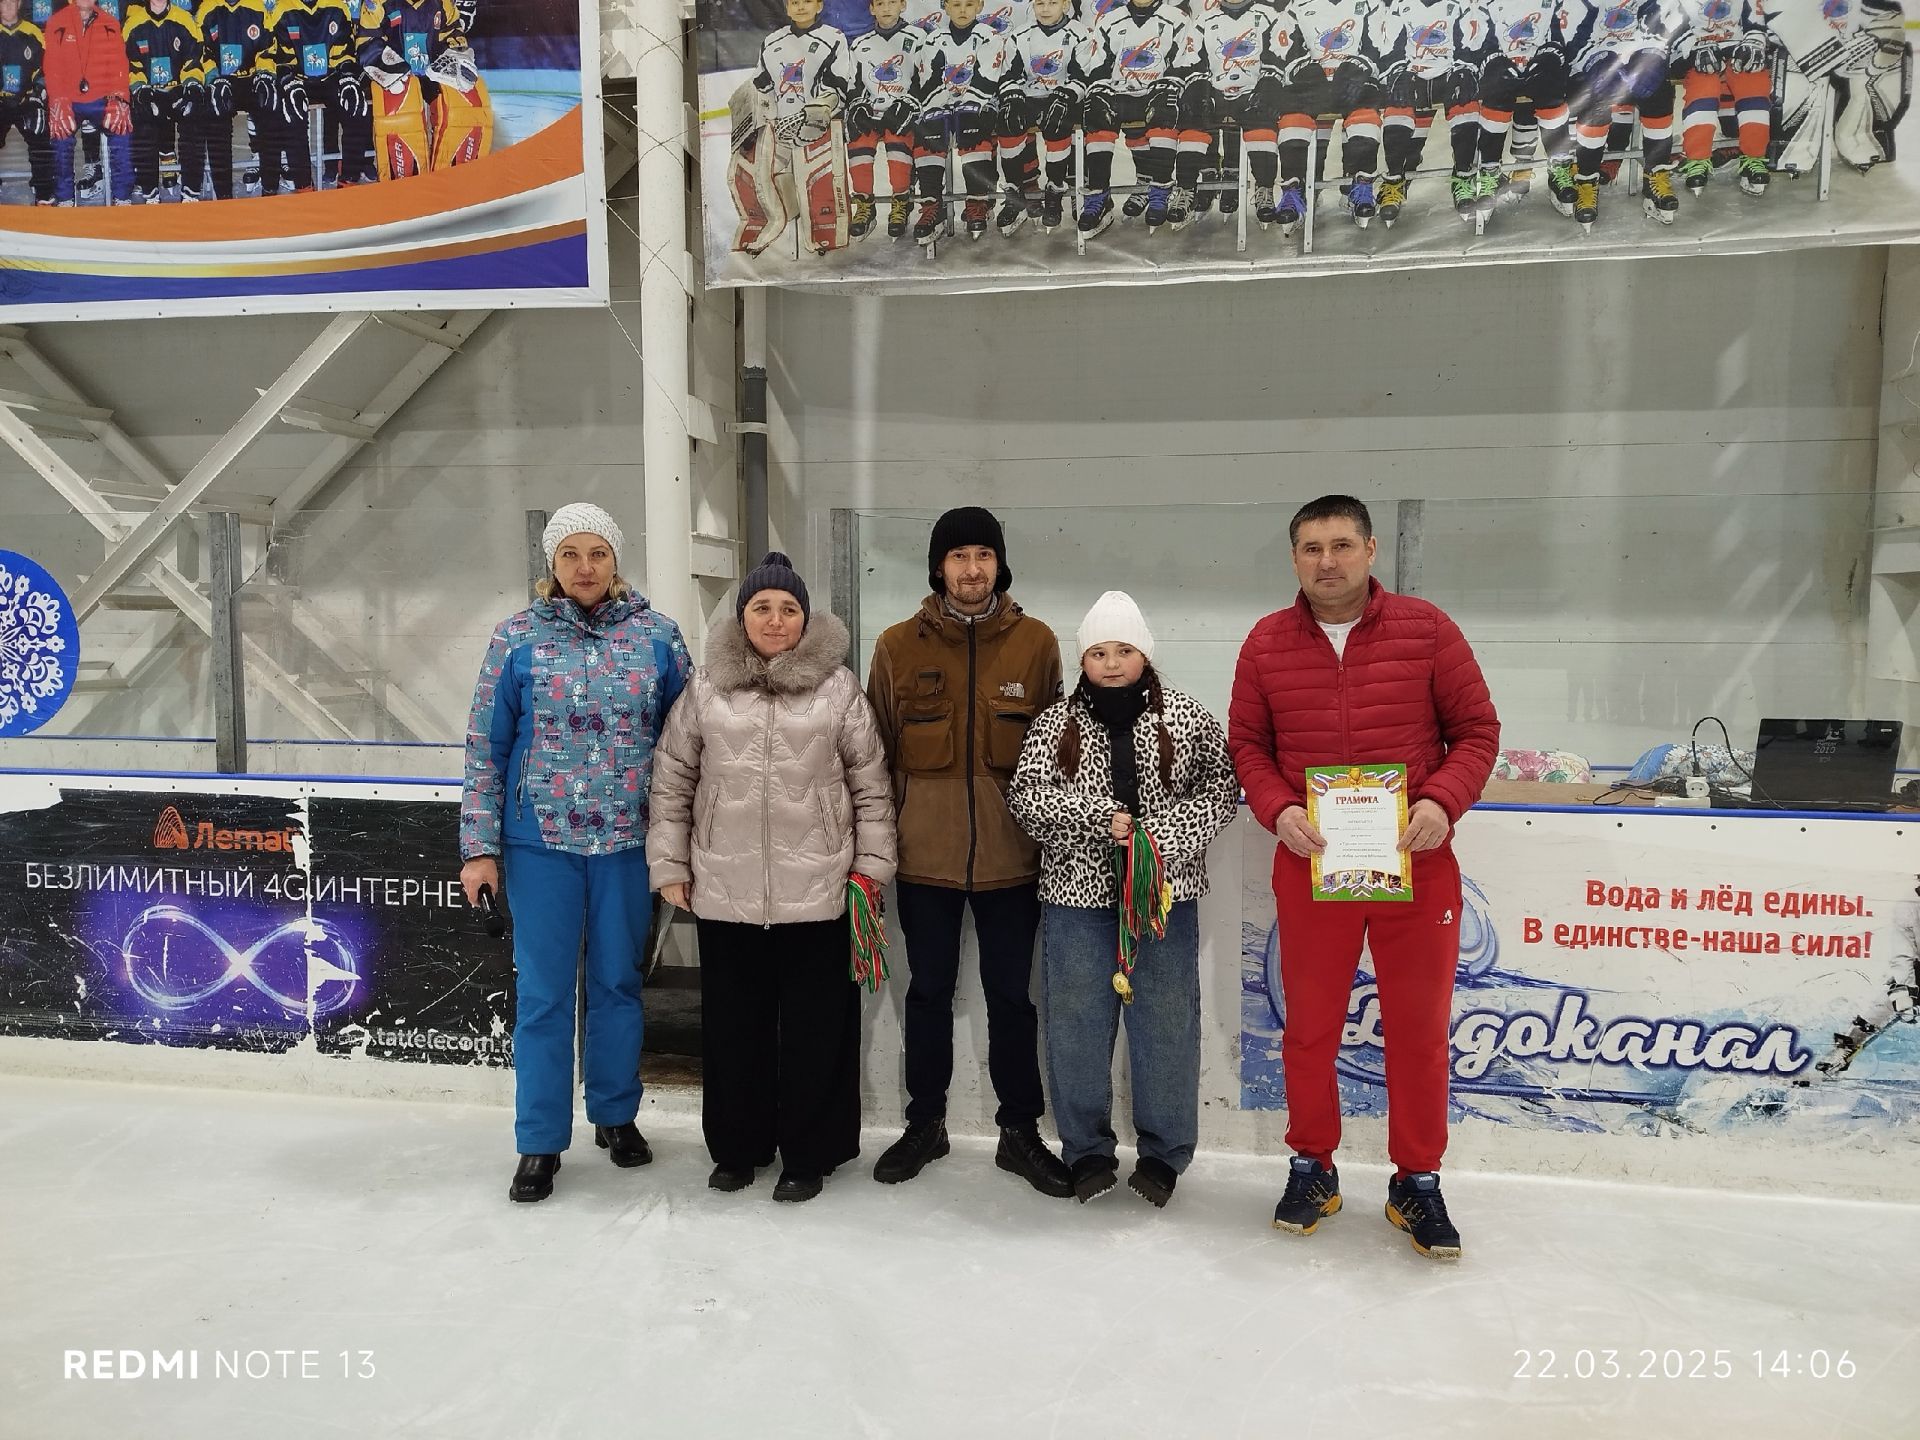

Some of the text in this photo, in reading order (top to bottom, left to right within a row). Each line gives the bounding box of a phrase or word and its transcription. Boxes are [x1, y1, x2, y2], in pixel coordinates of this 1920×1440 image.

[1813, 746, 1836, 755] 2010
[1335, 795, 1379, 805] ГРАМОТА
[26, 862, 463, 908] БЕЗЛИМИТНЫЙ 4G ИНТЕРНЕ
[1586, 879, 1874, 918] Вода и лёд едины.
[1523, 917, 1873, 959] В единстве-наша сила!
[377, 1028, 513, 1054] tattelecom.r
